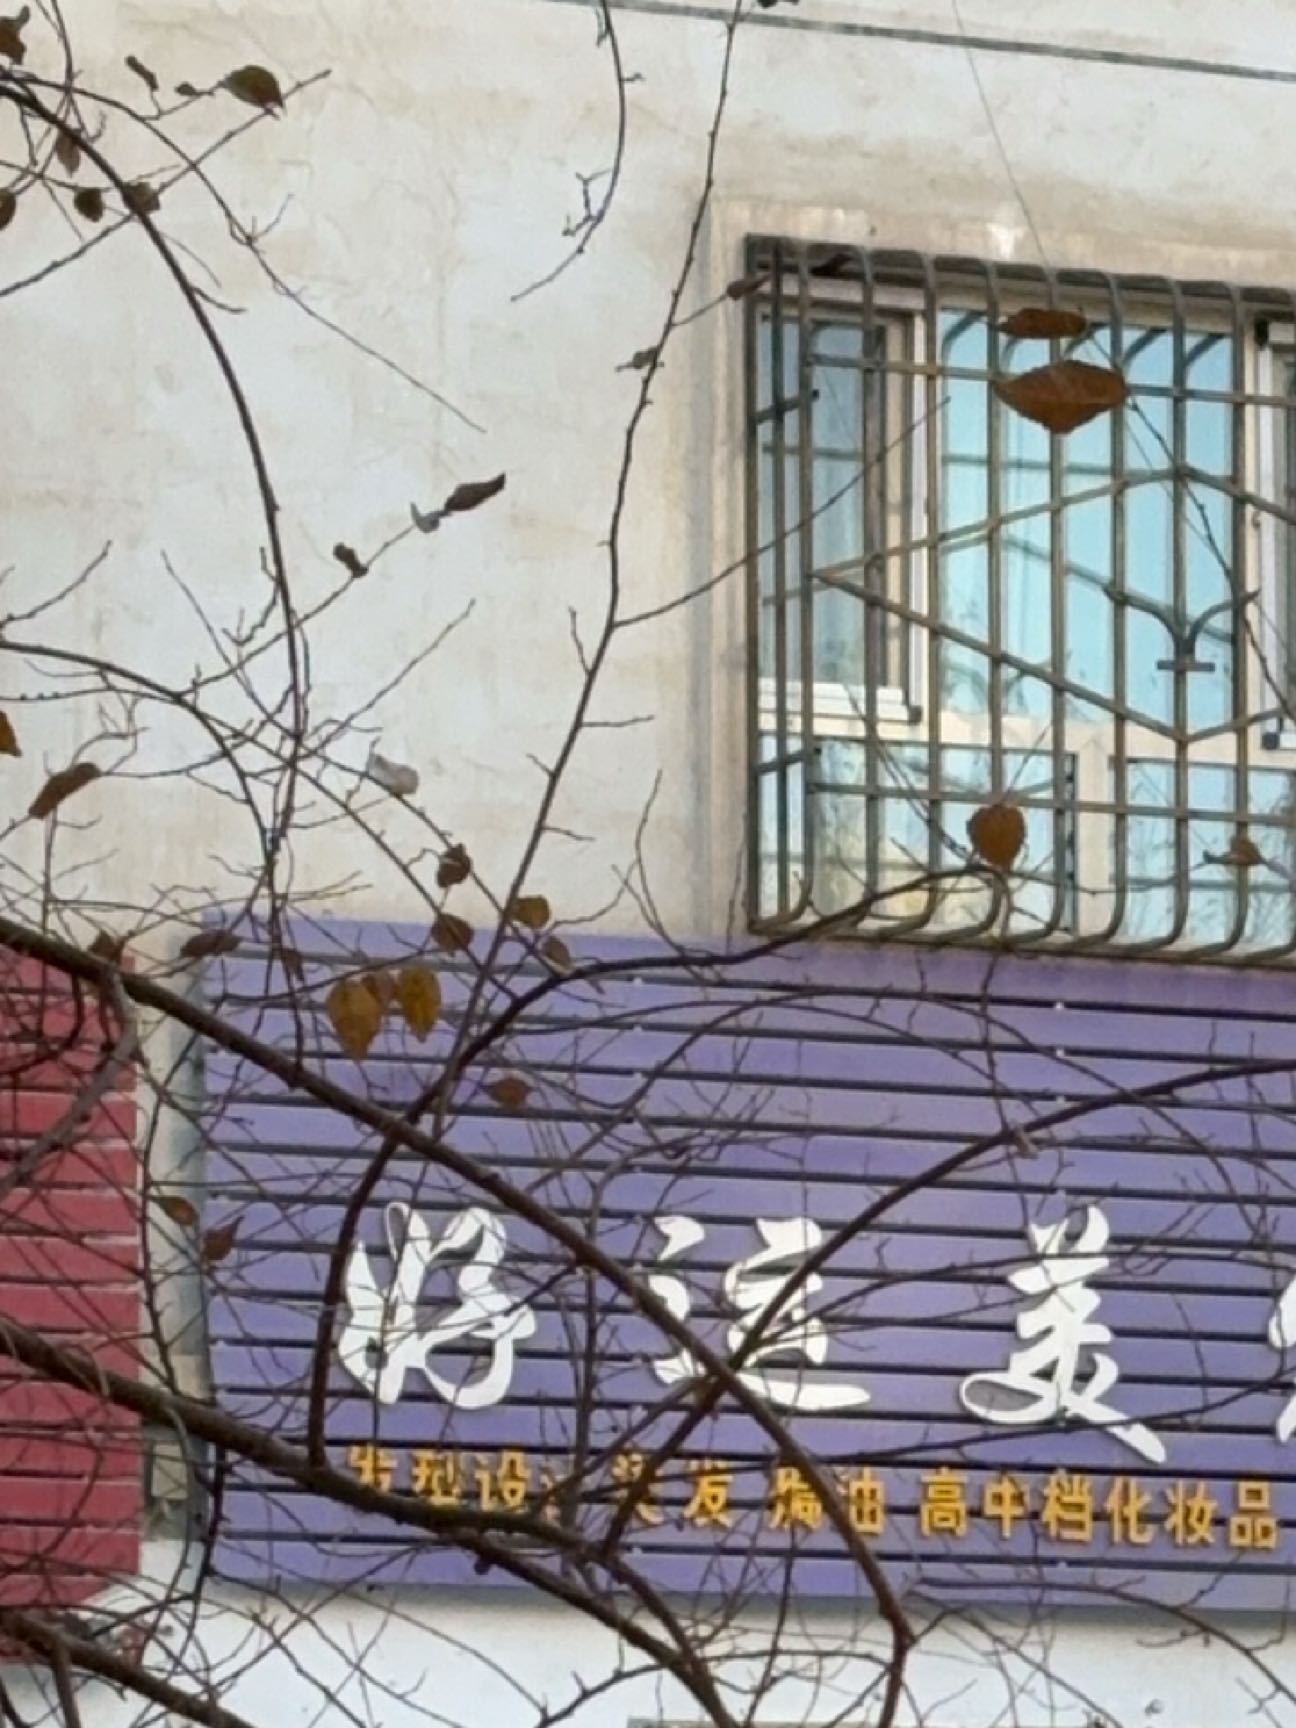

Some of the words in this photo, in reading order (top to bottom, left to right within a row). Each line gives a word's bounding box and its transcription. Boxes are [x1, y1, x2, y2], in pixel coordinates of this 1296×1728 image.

[920, 1466, 1278, 1550] 高中档化妆品
